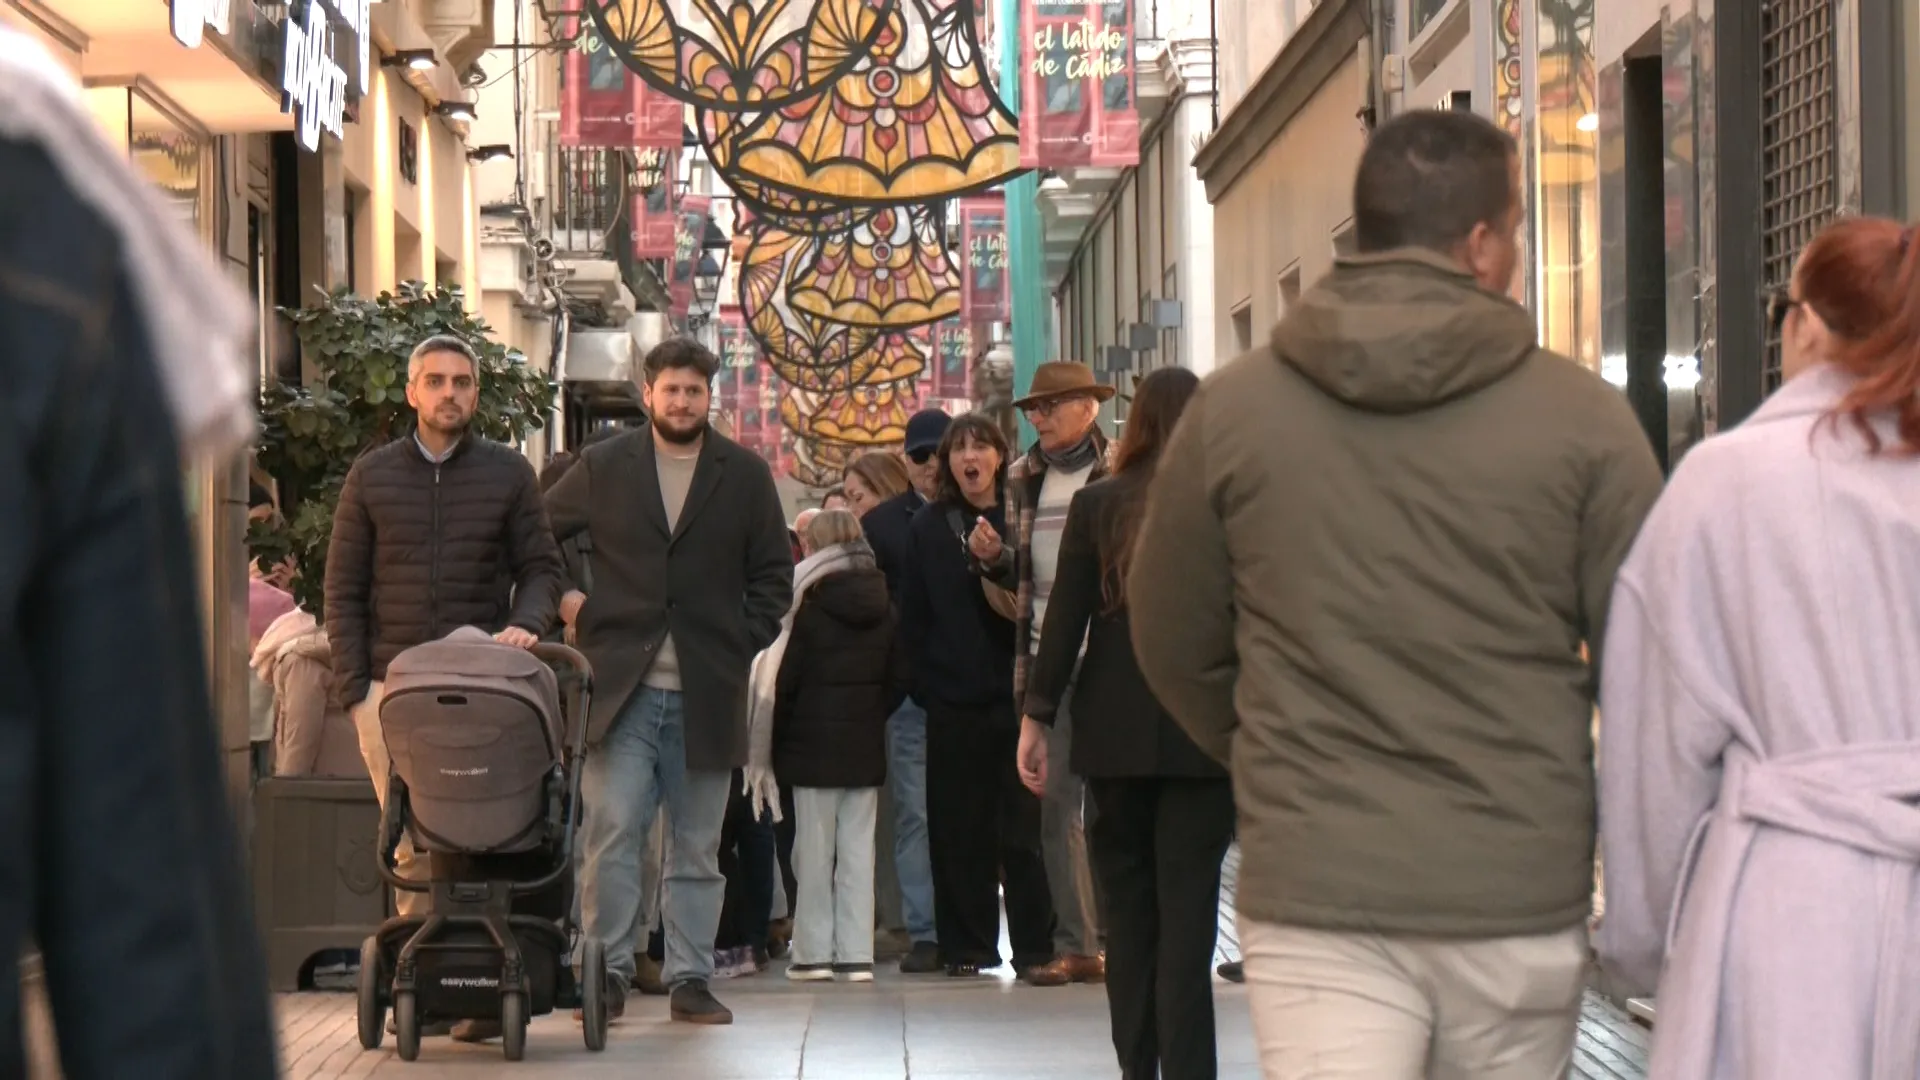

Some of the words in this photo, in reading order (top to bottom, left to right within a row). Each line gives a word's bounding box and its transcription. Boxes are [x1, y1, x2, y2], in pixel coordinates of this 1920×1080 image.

[1034, 23, 1055, 51] el
[1062, 17, 1125, 51] latido
[1031, 52, 1059, 77] de
[1066, 51, 1125, 79] Cádiz
[440, 977, 499, 987] easywalker
